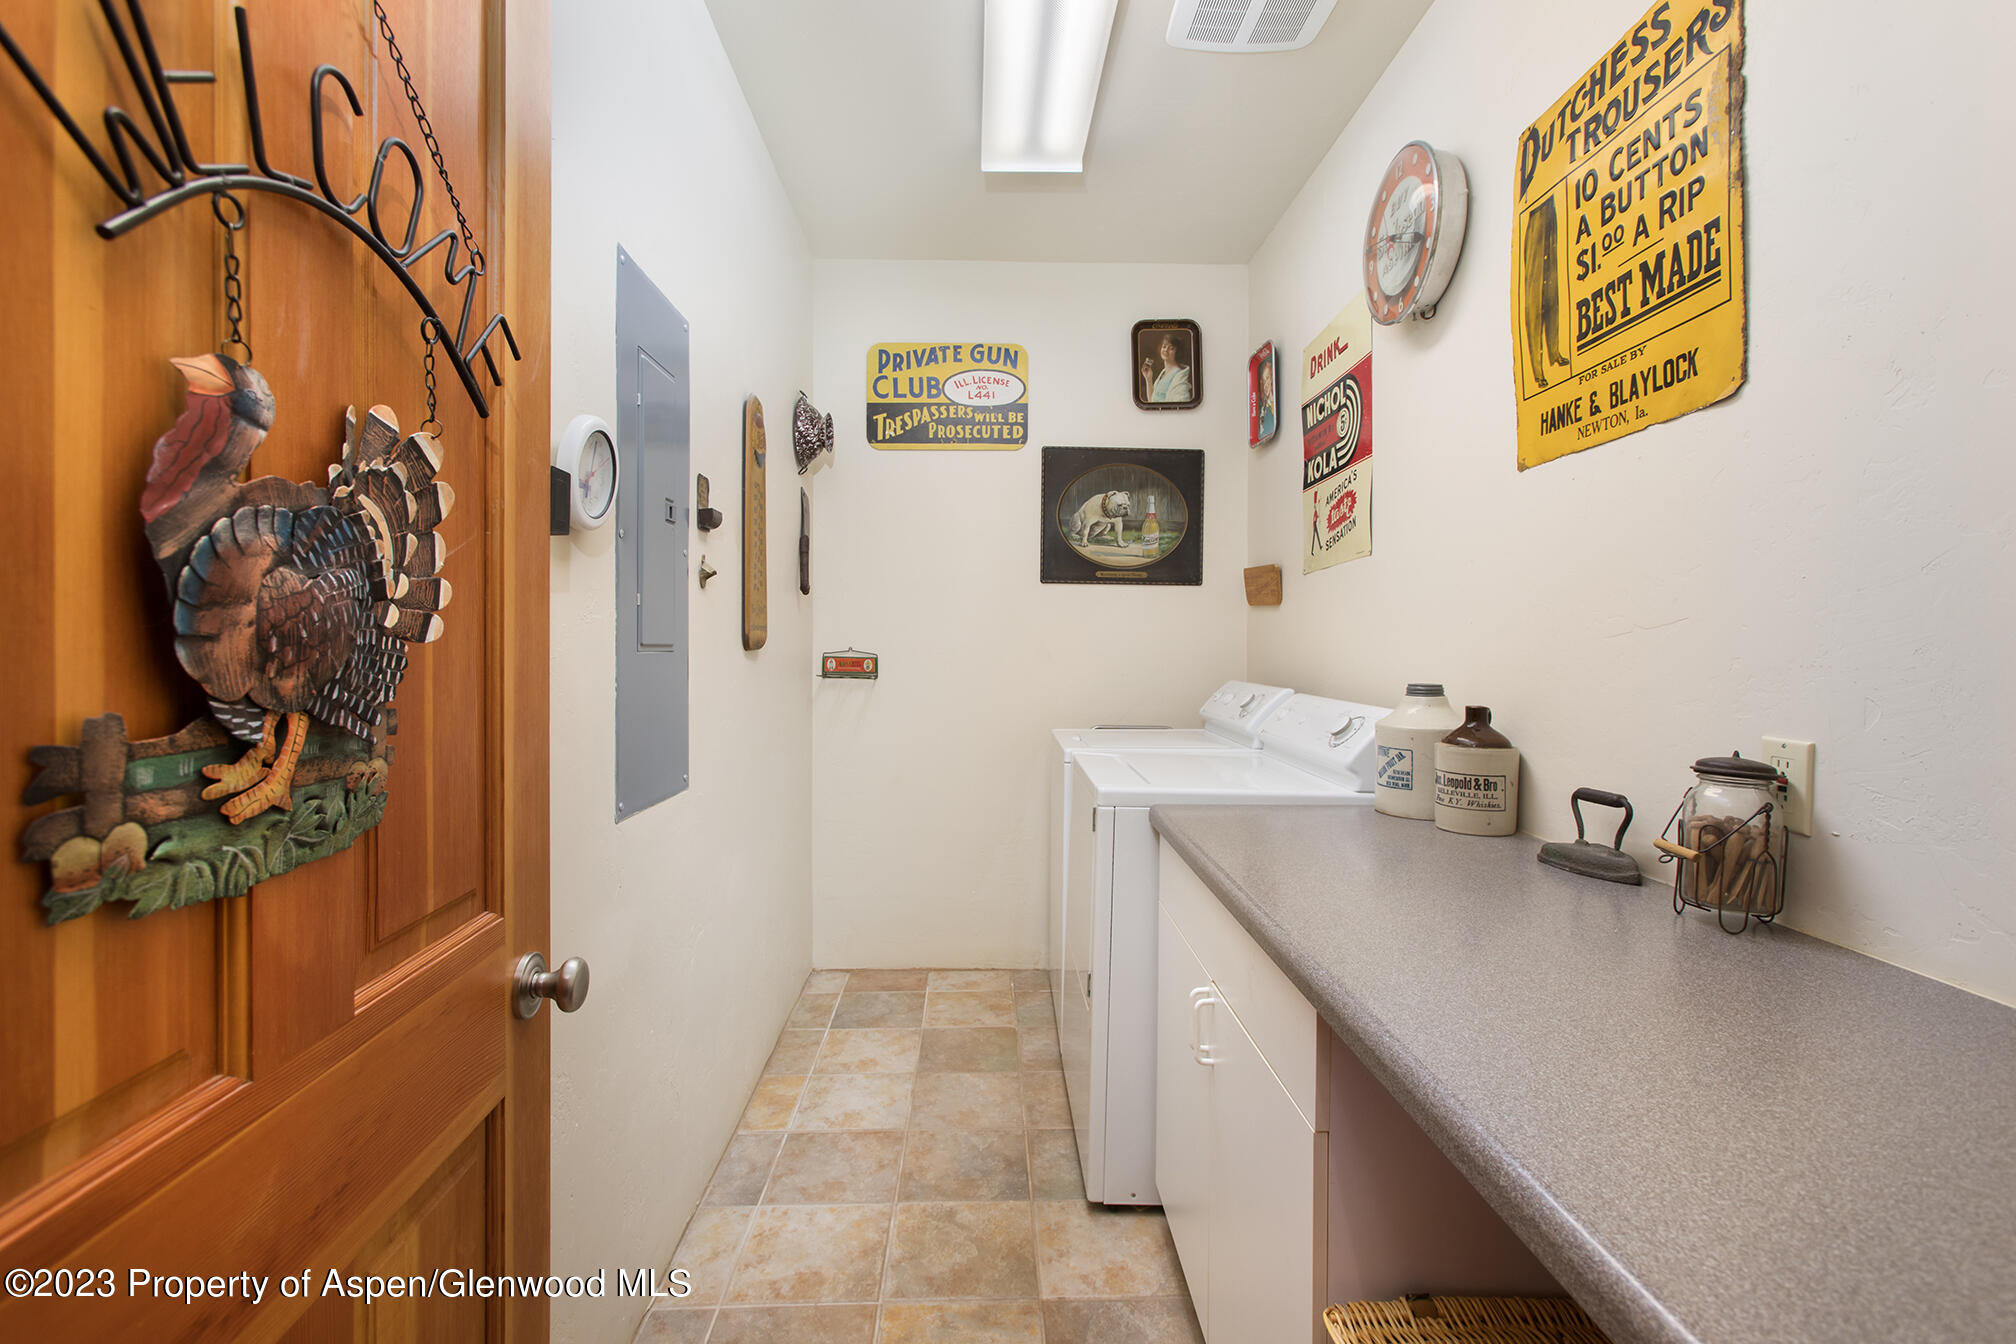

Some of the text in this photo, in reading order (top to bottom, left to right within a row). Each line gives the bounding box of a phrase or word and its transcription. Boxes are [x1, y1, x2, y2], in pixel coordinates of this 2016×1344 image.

[1518, 1, 1672, 203] DUTCHESS
[1565, 0, 1734, 165] TROUSERS
[1575, 87, 1703, 210] 10 CENTS
[1575, 124, 1709, 246] A BUTTON
[1632, 213, 1651, 248] A
[1658, 175, 1706, 231] RIP
[1575, 215, 1722, 343] BEST MADE
[1398, 298, 1404, 313] 6
[877, 343, 1019, 374] PRIVATE GUN
[1309, 335, 1348, 380] DRINK
[1578, 344, 1648, 386] FOR SALE BY
[872, 374, 943, 400] CLUB
[972, 375, 1011, 389] LICENSE
[1540, 346, 1700, 437] HANKE & BLAYLOCK
[872, 404, 1025, 442] TRESPASSERS WILL BE
[1306, 381, 1347, 430] NICHOL
[928, 422, 1024, 440] PROSECUTED
[1576, 410, 1630, 441] NEWTON,
[1306, 446, 1338, 485] KOLA
[1325, 468, 1358, 507] AMERICA'S
[1325, 515, 1357, 552] SENSATION
[1443, 773, 1472, 791] Leopold
[1473, 777, 1482, 792] &
[1483, 778, 1498, 792] Bro
